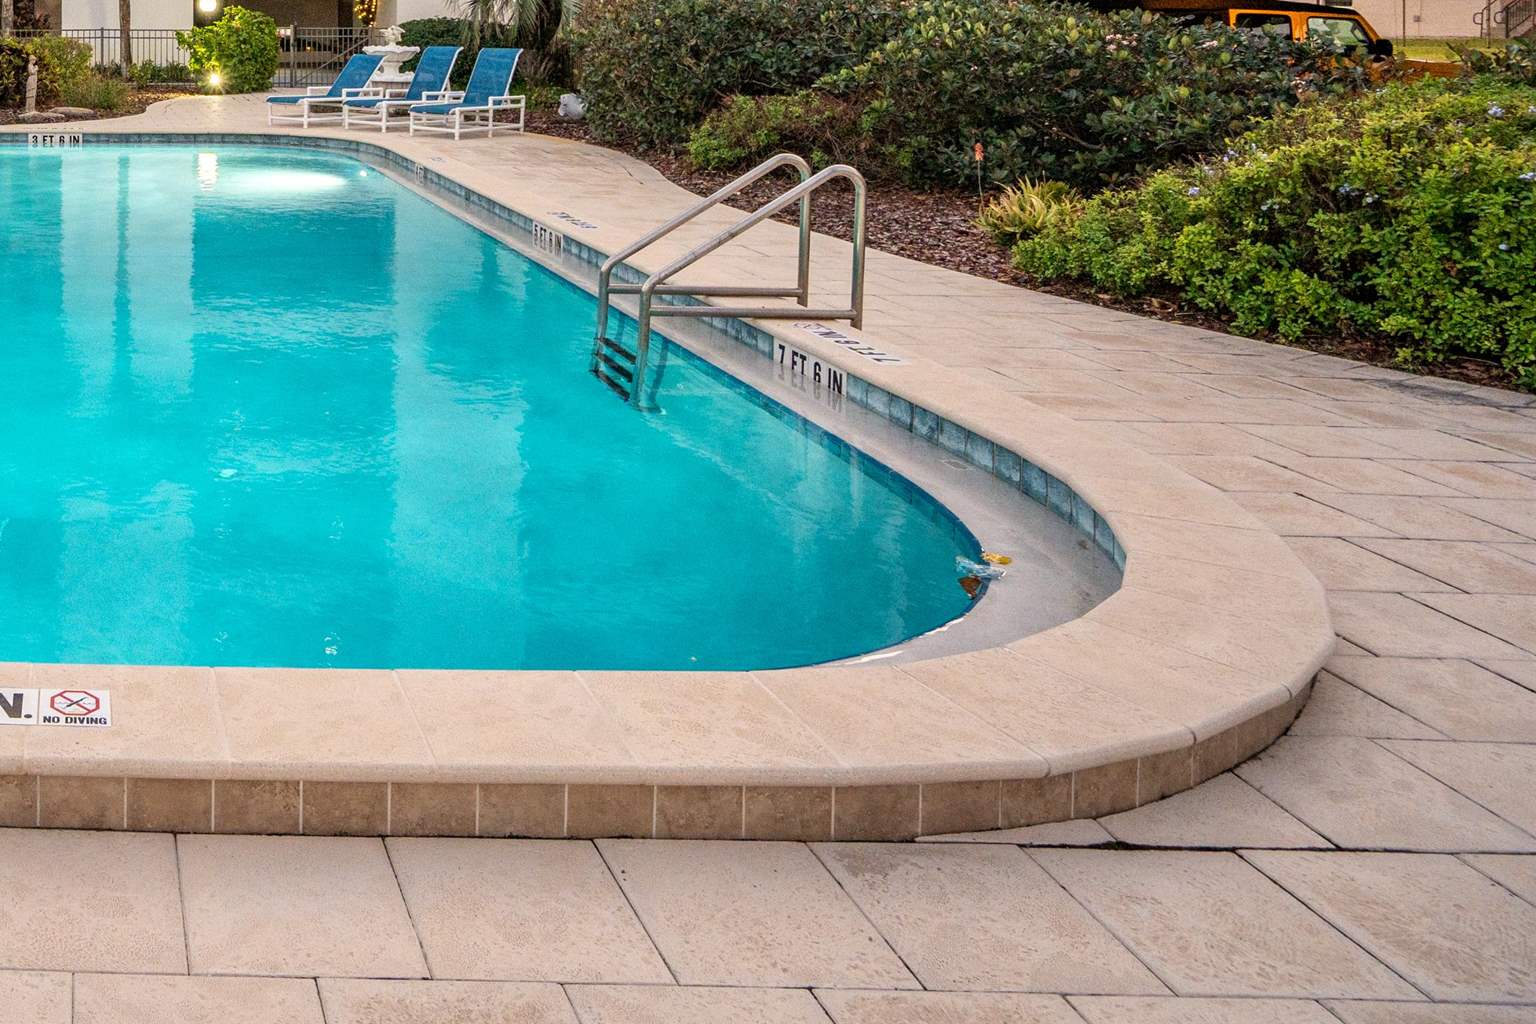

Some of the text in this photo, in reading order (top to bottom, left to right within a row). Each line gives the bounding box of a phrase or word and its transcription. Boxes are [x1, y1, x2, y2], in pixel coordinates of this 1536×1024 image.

[32, 135, 38, 144] 3
[43, 135, 54, 144] FT
[69, 135, 80, 144] IN
[778, 344, 843, 395] 7 FT 6 IN
[43, 716, 108, 725] NO DIVING
